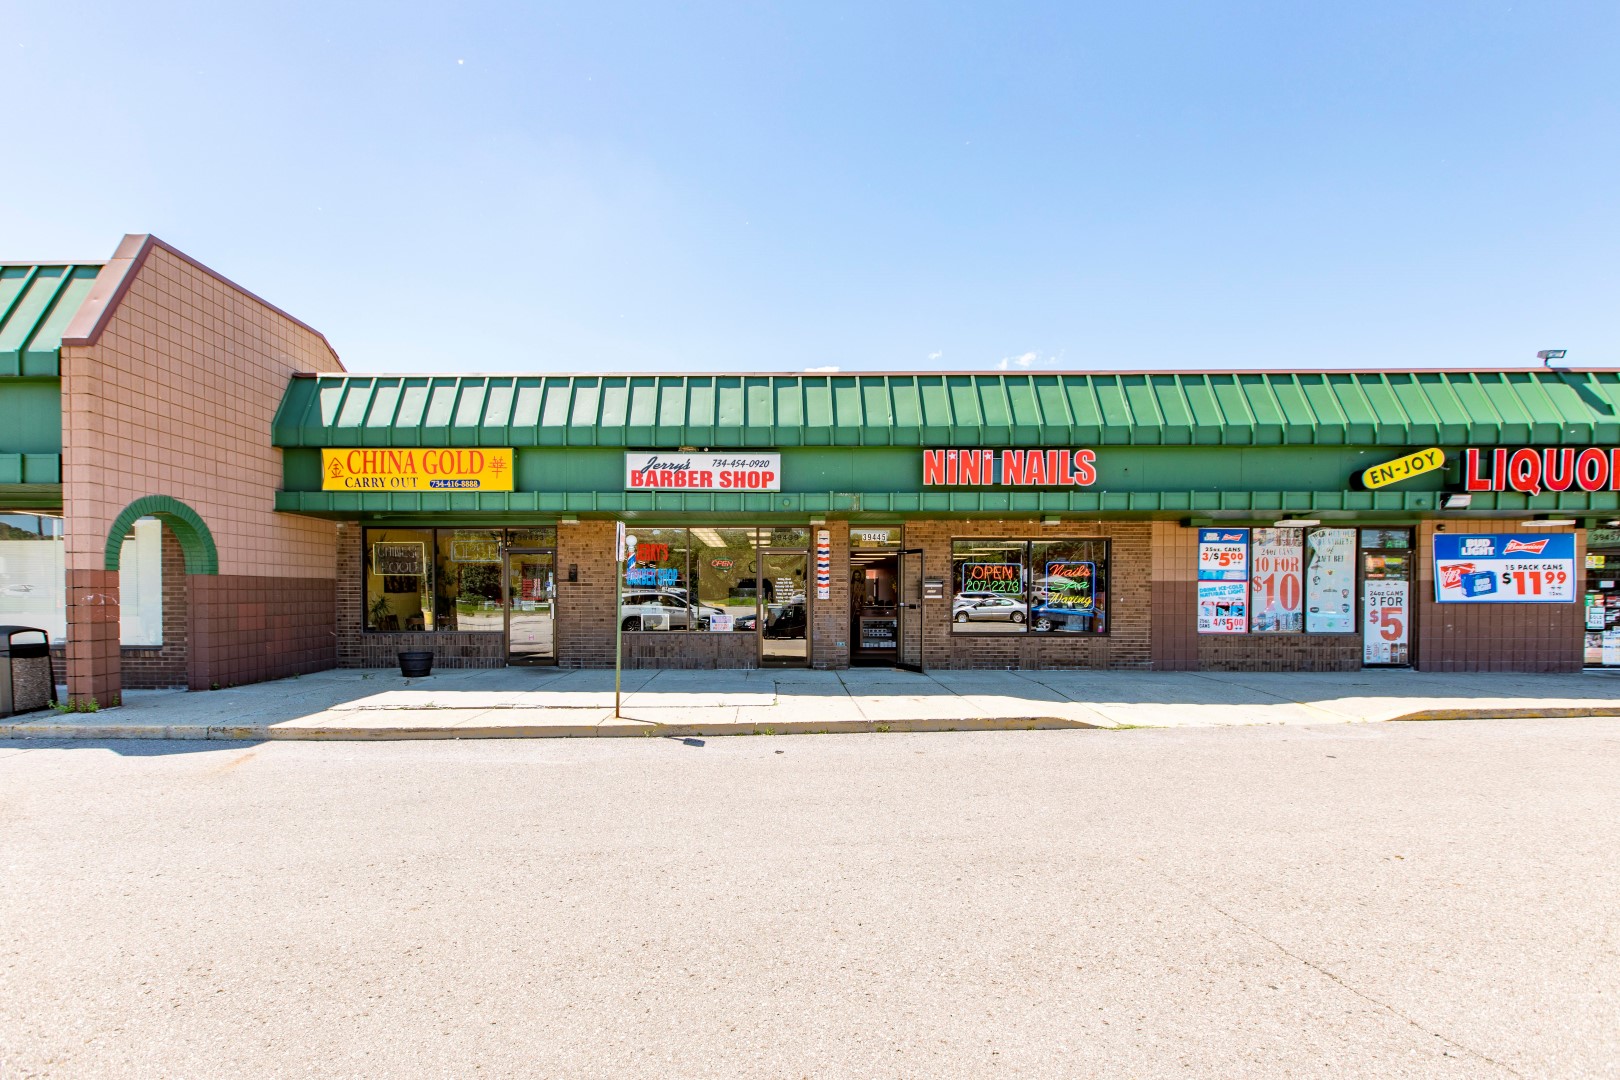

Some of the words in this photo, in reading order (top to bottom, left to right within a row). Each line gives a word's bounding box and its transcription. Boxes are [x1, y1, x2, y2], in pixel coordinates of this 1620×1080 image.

[346, 450, 417, 475] CHINA
[422, 450, 484, 475] GOLD
[640, 456, 691, 474] Jerry's
[712, 459, 770, 468] 734-454-0920
[1001, 449, 1097, 486] NAILS
[1369, 451, 1437, 485] EN-JOY
[345, 477, 386, 488] CARRY
[390, 477, 418, 488] OUT
[431, 480, 479, 488] 734-416-8888
[631, 470, 713, 488] BARBER
[719, 471, 775, 488] SHOP
[1466, 539, 1491, 547] BUD
[1507, 540, 1544, 551] Budweiser
[636, 543, 669, 561] JERRY'S
[1461, 546, 1495, 556] LIGHT
[381, 562, 418, 573] FOOD
[1050, 564, 1091, 577] Nails
[1255, 557, 1269, 572] 10
[1274, 557, 1299, 572] FOR
[626, 567, 656, 586] BARBER
[657, 567, 679, 586] SHOP
[972, 566, 1013, 579] OPEN
[966, 580, 1019, 592] 207-2273
[1050, 579, 1090, 591] Spa
[1253, 573, 1300, 611] $10
[1048, 592, 1092, 608] Waxing
[1370, 597, 1377, 606] 3
[1380, 597, 1403, 606] FOR
[1369, 607, 1403, 641] $5
